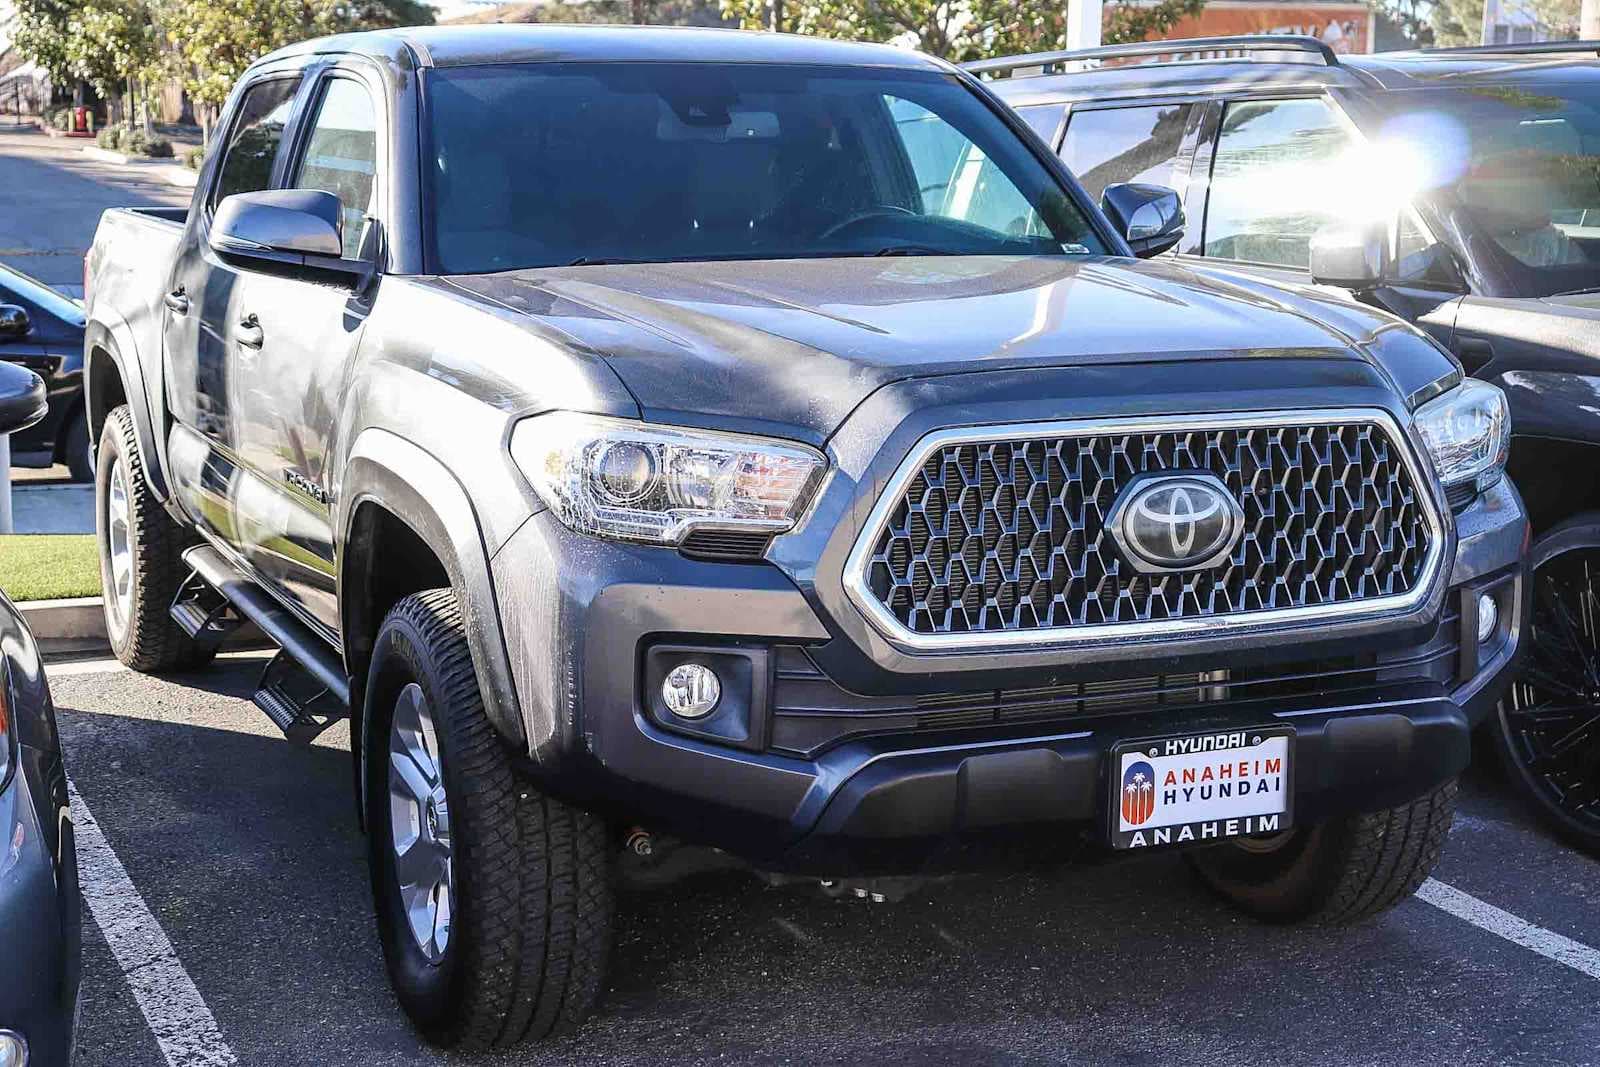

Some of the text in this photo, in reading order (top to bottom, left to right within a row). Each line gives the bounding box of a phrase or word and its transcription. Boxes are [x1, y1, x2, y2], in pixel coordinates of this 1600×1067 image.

[1165, 733, 1246, 755] HYUNDAI
[1164, 758, 1281, 786] ANAHEIM
[1163, 777, 1280, 805] HYUNDAI
[1129, 814, 1279, 848] ANAHEIM
